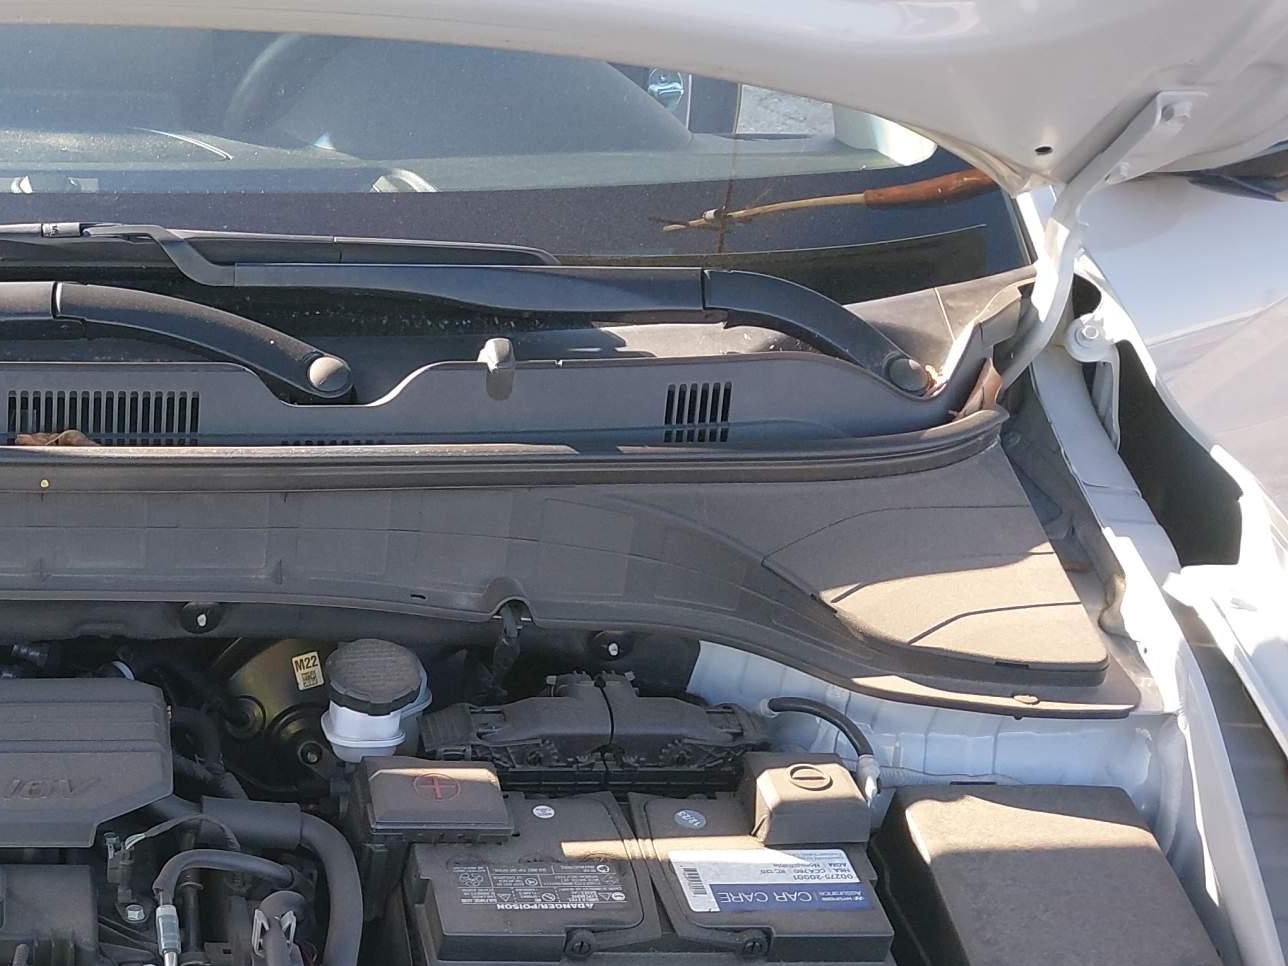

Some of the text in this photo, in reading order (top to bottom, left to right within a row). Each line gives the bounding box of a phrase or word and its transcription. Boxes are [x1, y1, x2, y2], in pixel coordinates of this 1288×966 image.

[294, 655, 319, 673] M22
[717, 891, 812, 903] CAR CARE
